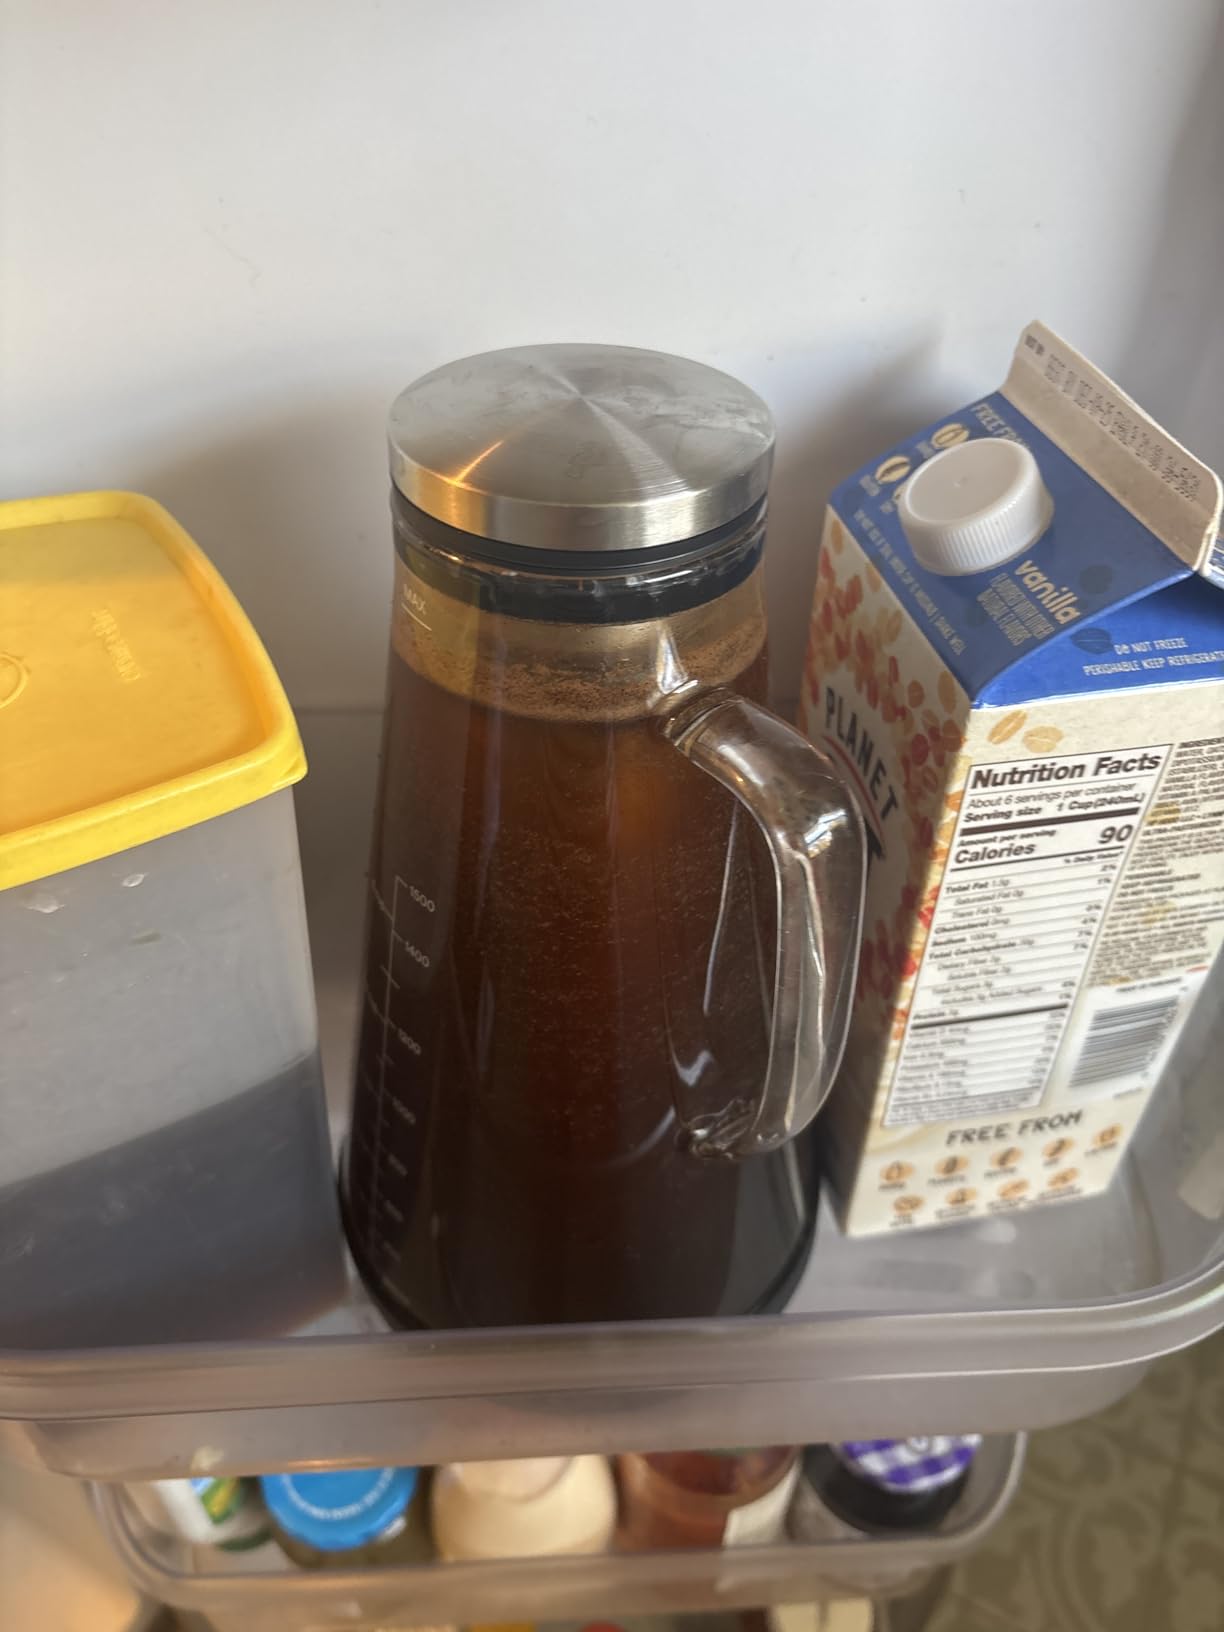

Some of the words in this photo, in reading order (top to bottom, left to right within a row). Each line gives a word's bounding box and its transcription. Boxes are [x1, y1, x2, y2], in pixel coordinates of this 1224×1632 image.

[1014, 559, 1081, 625] vanilla
[1131, 641, 1152, 653] NOT
[1154, 637, 1188, 650] FREEZE
[1142, 657, 1166, 670] KEEP
[825, 685, 899, 821] PLANET
[971, 762, 1086, 789] Nutrition
[1093, 751, 1162, 777] Facts
[966, 796, 1001, 811] About
[1004, 794, 1012, 805] 6
[1013, 789, 1061, 804] servings
[1063, 789, 1084, 800] per
[1086, 782, 1138, 795] container
[963, 808, 1012, 823] Serving
[1016, 805, 1043, 817] size
[954, 843, 1037, 865] Calories
[1098, 824, 1134, 845] 90
[957, 836, 998, 848] Amount
[1000, 833, 1018, 844] per
[1019, 829, 1058, 840] serving
[408, 884, 436, 913] 1500
[404, 940, 431, 968] 1400
[945, 1122, 1011, 1147] FREE
[1017, 1109, 1084, 1136] FROM
